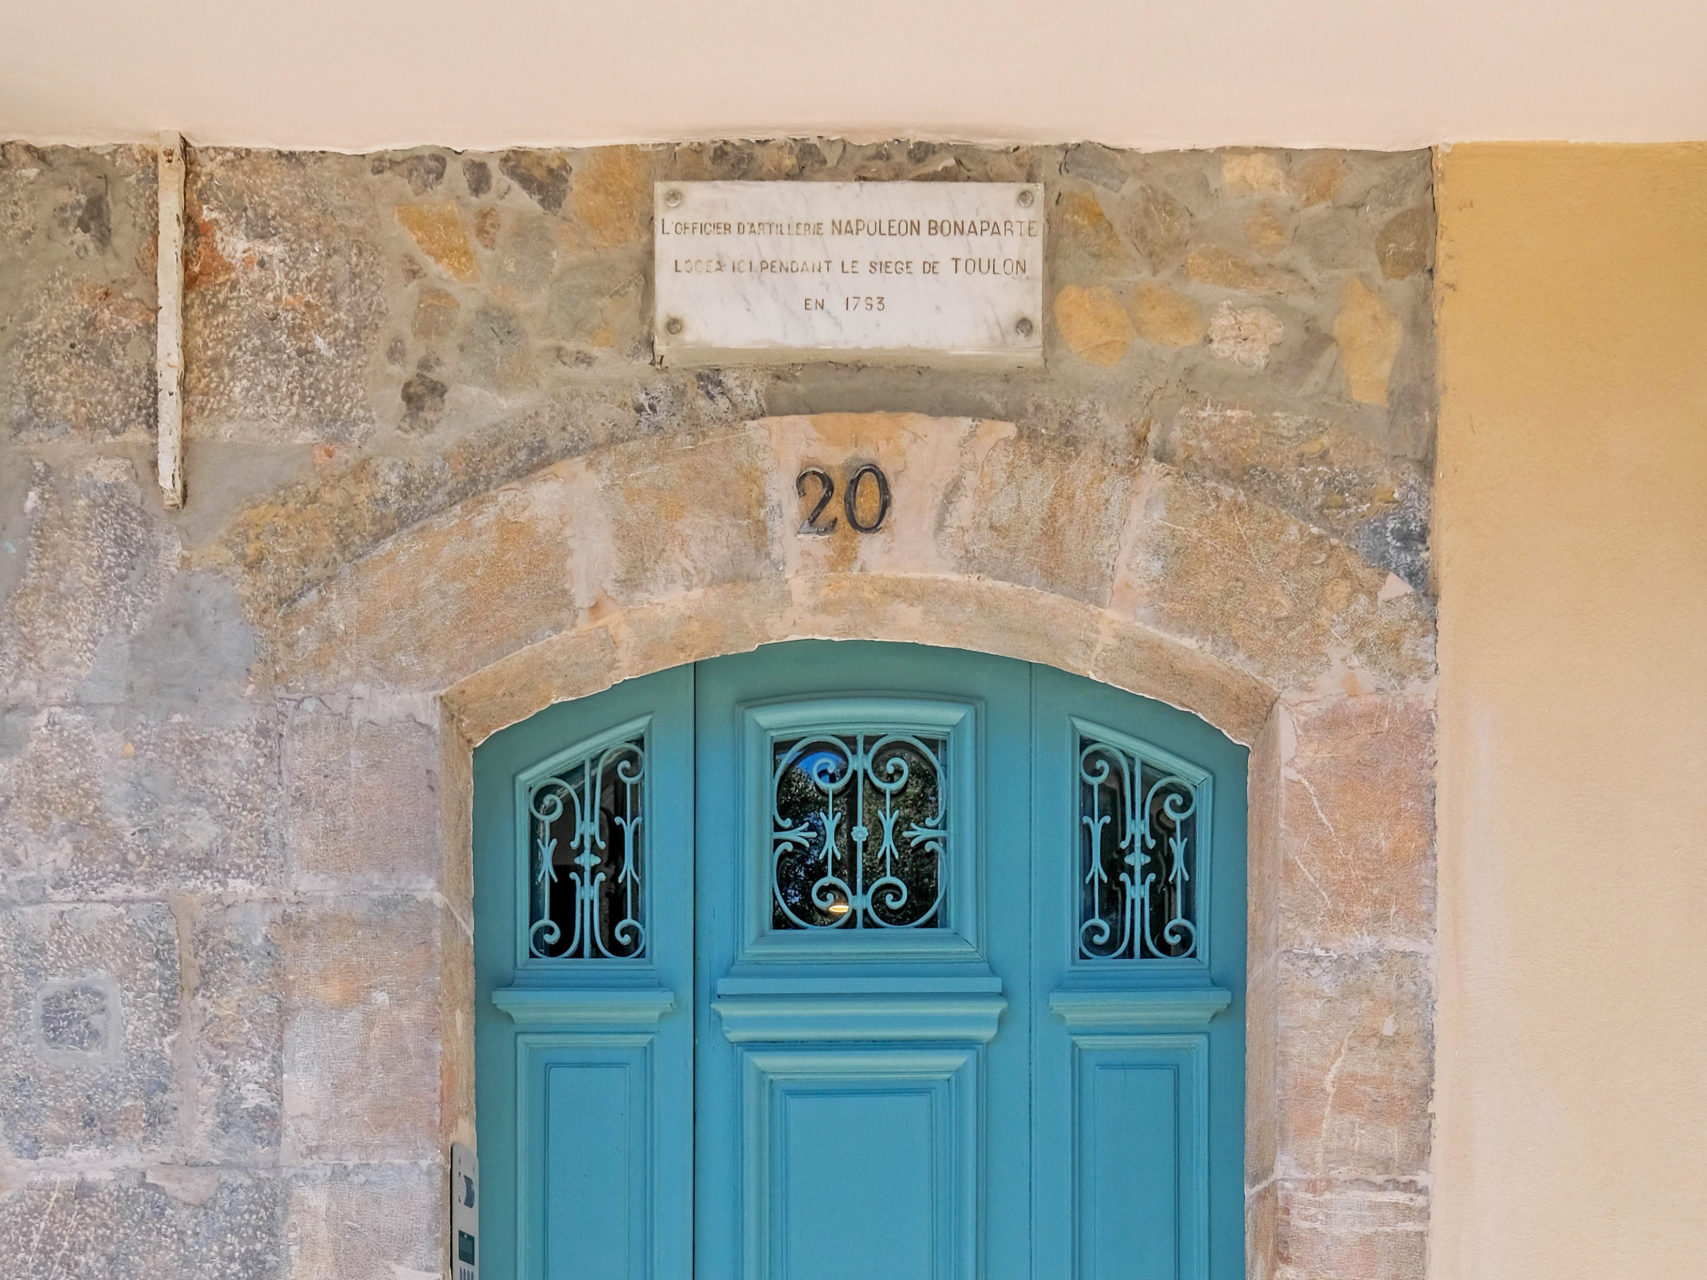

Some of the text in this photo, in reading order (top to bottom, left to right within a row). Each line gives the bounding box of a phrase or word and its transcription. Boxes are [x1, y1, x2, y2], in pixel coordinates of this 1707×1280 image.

[831, 218, 921, 237] NAPOLEON
[928, 219, 1037, 237] BONAPARTE
[732, 260, 753, 274] ICI
[760, 260, 832, 274] PENDANT
[841, 260, 859, 274] LE
[869, 261, 913, 275] SIEGE
[922, 261, 940, 275] DE
[951, 257, 1027, 275] TOULON
[804, 298, 825, 311] EN
[796, 463, 891, 537] 20
